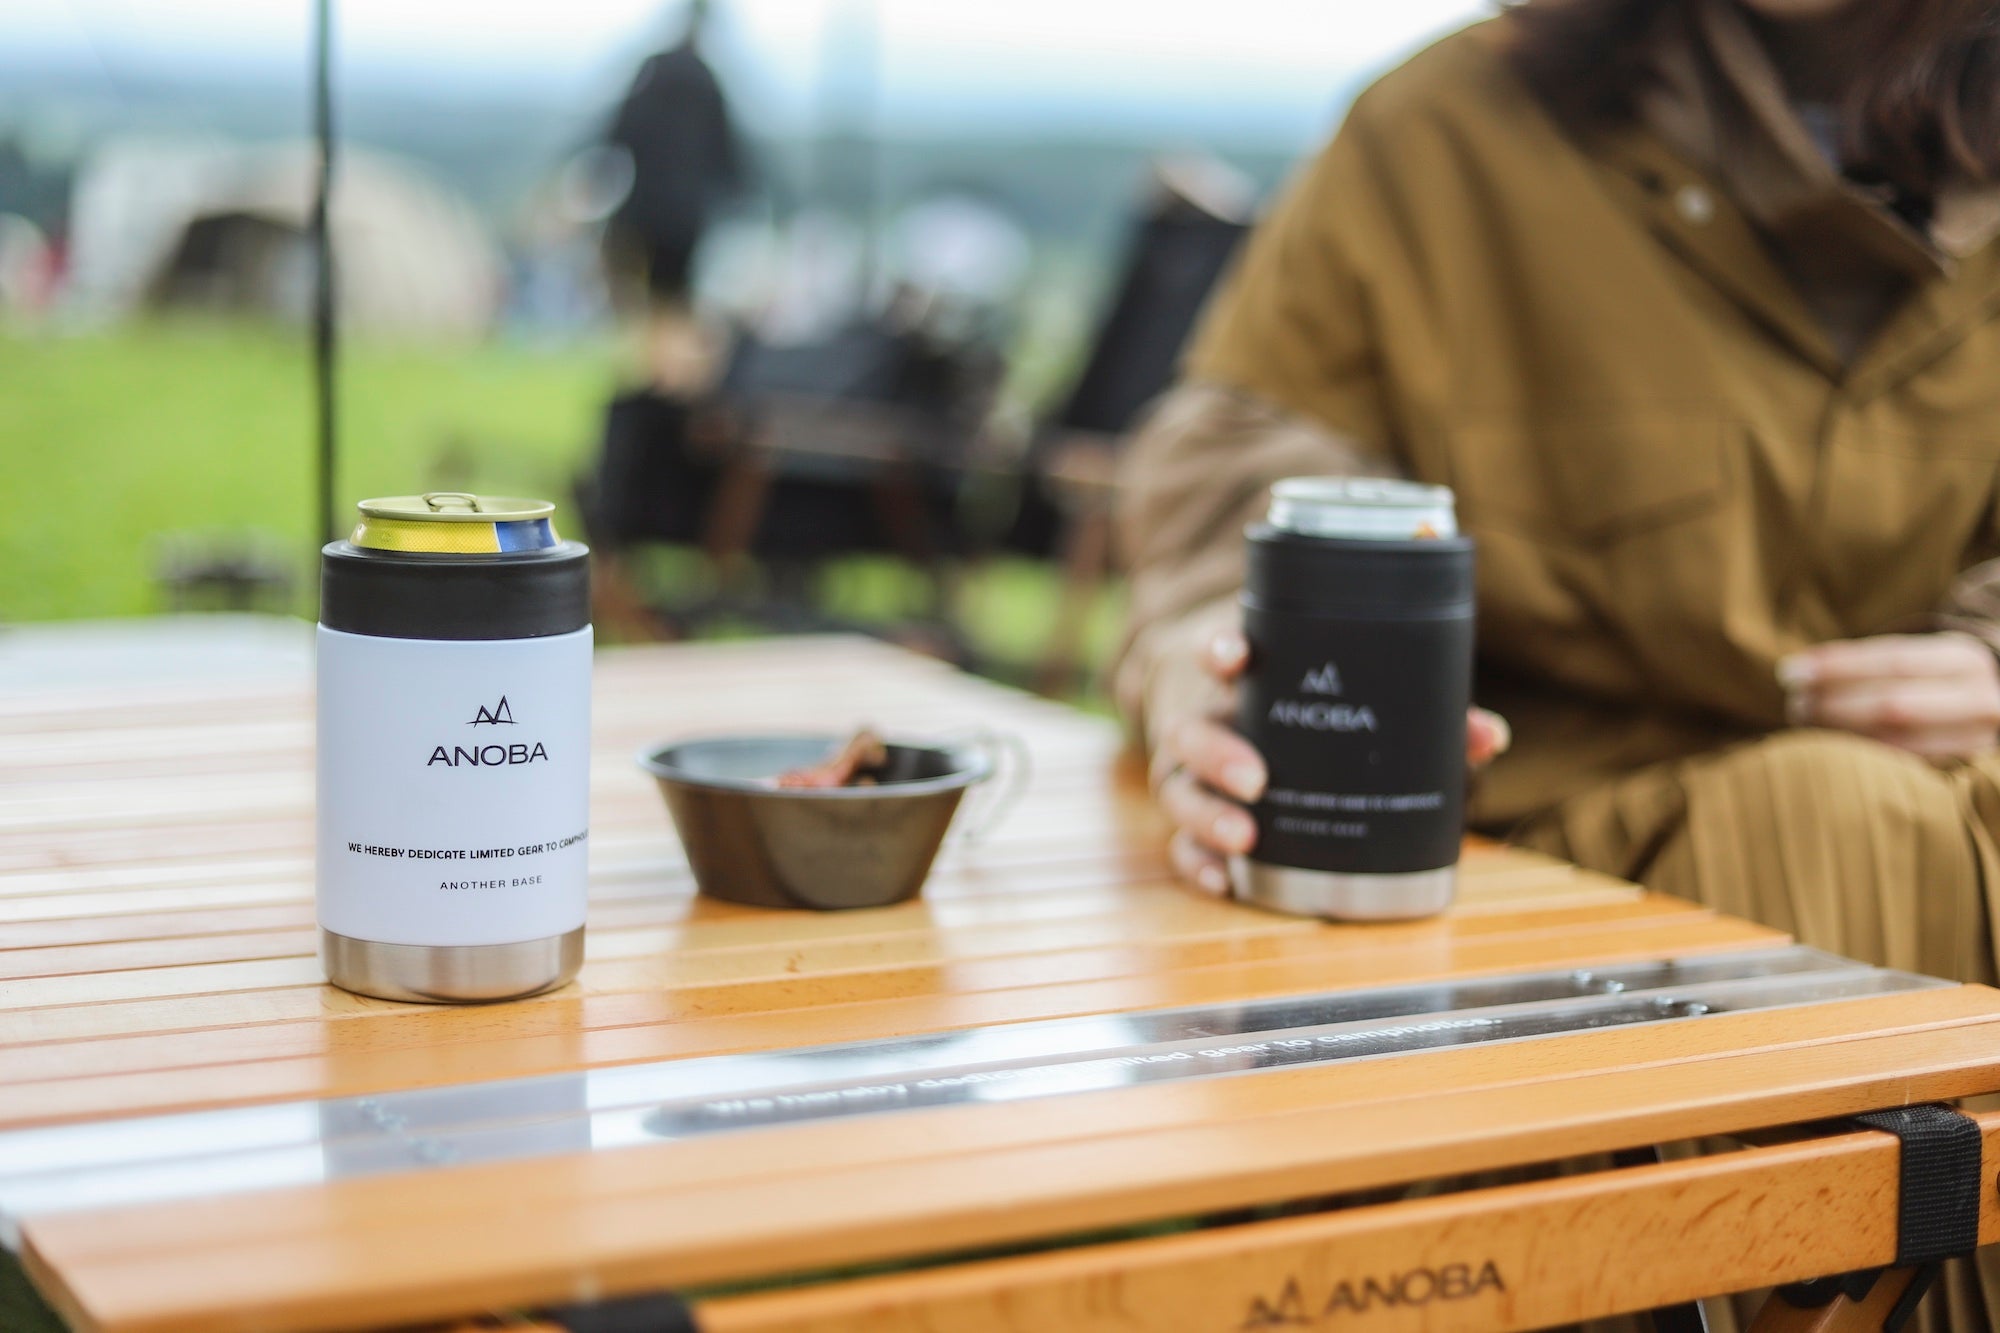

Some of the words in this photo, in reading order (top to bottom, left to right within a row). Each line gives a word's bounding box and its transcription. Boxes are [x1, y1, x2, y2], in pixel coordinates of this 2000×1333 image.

[1267, 700, 1378, 732] ANOBA
[427, 742, 549, 767] ANOBA
[348, 842, 362, 853] WE
[364, 844, 405, 858] HEREBY
[408, 849, 466, 860] DEDICATE
[470, 848, 515, 859] LIMITED
[518, 844, 544, 856] GEAR
[546, 841, 558, 852] TO
[440, 879, 507, 890] ANOTHER
[512, 874, 544, 887] BASE
[1197, 1043, 1270, 1058] gear
[1272, 1038, 1312, 1048] to
[1324, 1260, 1506, 1316] ANOBA
